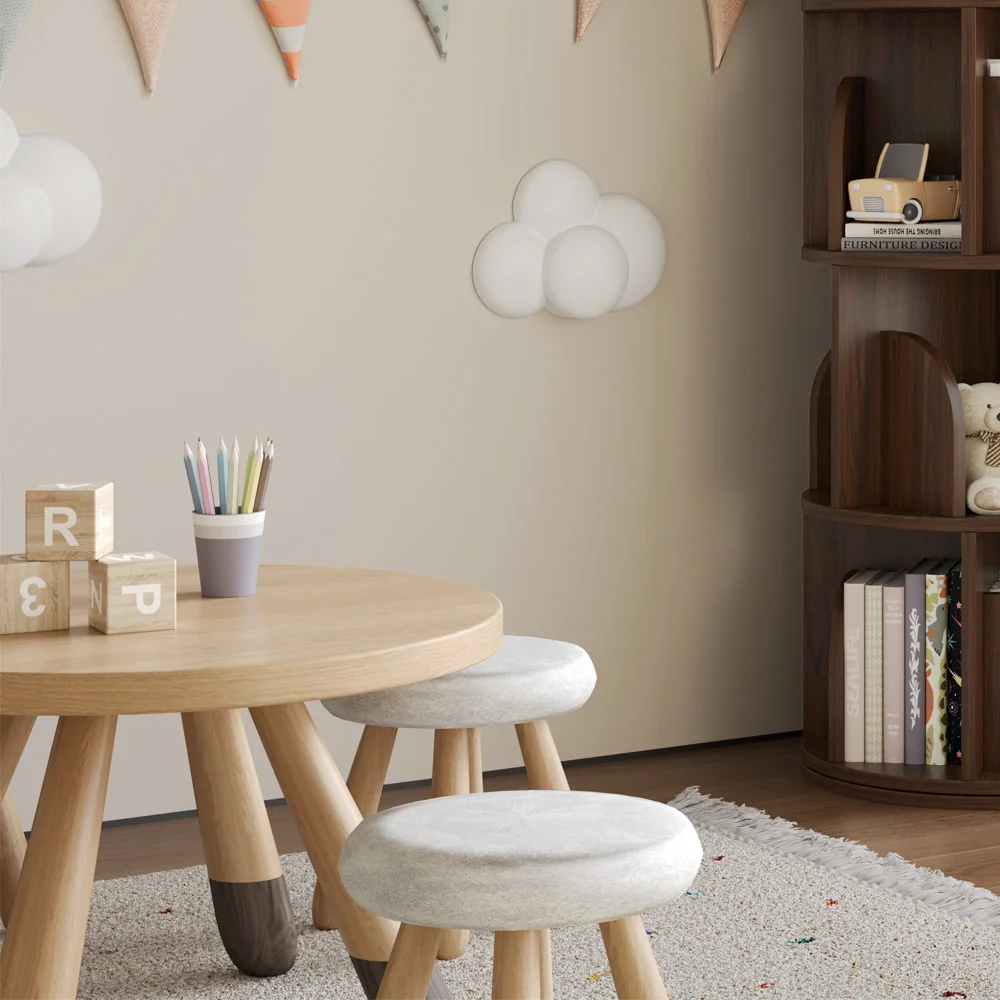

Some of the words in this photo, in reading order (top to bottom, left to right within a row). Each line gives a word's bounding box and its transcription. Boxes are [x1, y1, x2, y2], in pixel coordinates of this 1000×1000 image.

[843, 240, 917, 250] FURNITURE
[44, 506, 80, 547] R
[90, 579, 103, 616] N
[121, 583, 161, 615] P
[847, 628, 860, 717] SEALIFE
